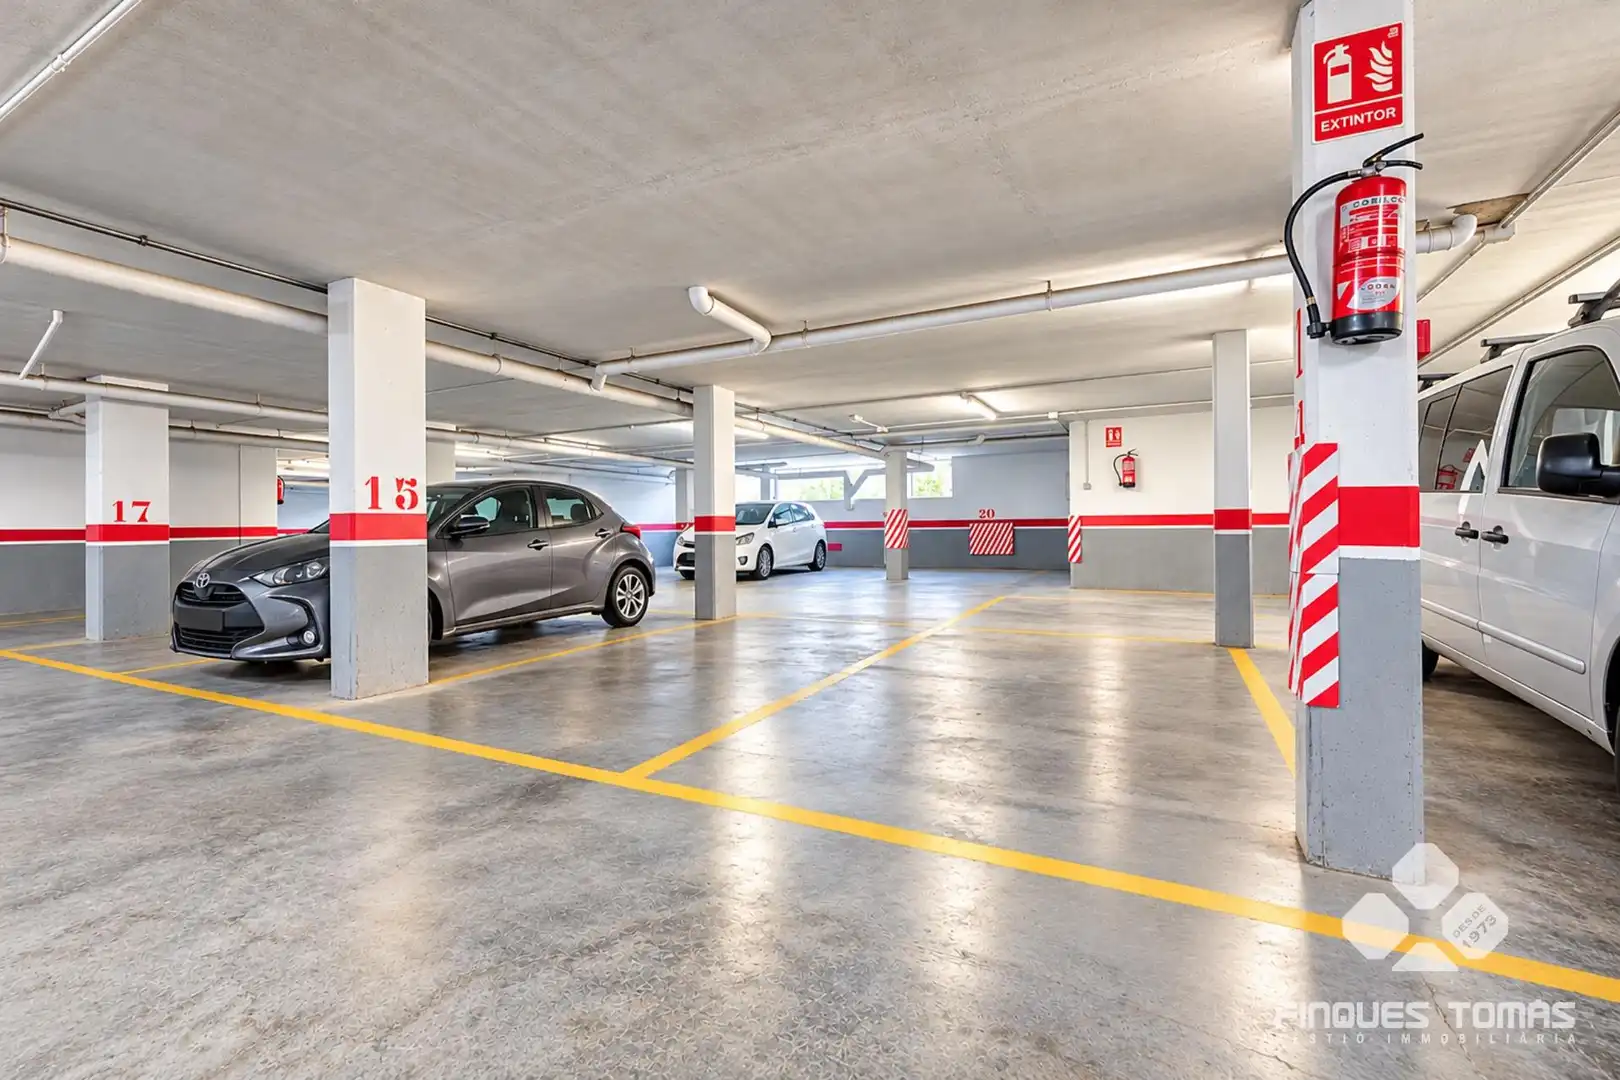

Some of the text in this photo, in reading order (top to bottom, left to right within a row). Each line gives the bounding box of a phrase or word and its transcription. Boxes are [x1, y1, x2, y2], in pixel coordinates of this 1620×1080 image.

[1321, 107, 1397, 132] EXTINTOR
[364, 476, 419, 510] 15
[112, 500, 151, 523] 17
[978, 508, 996, 520] 20
